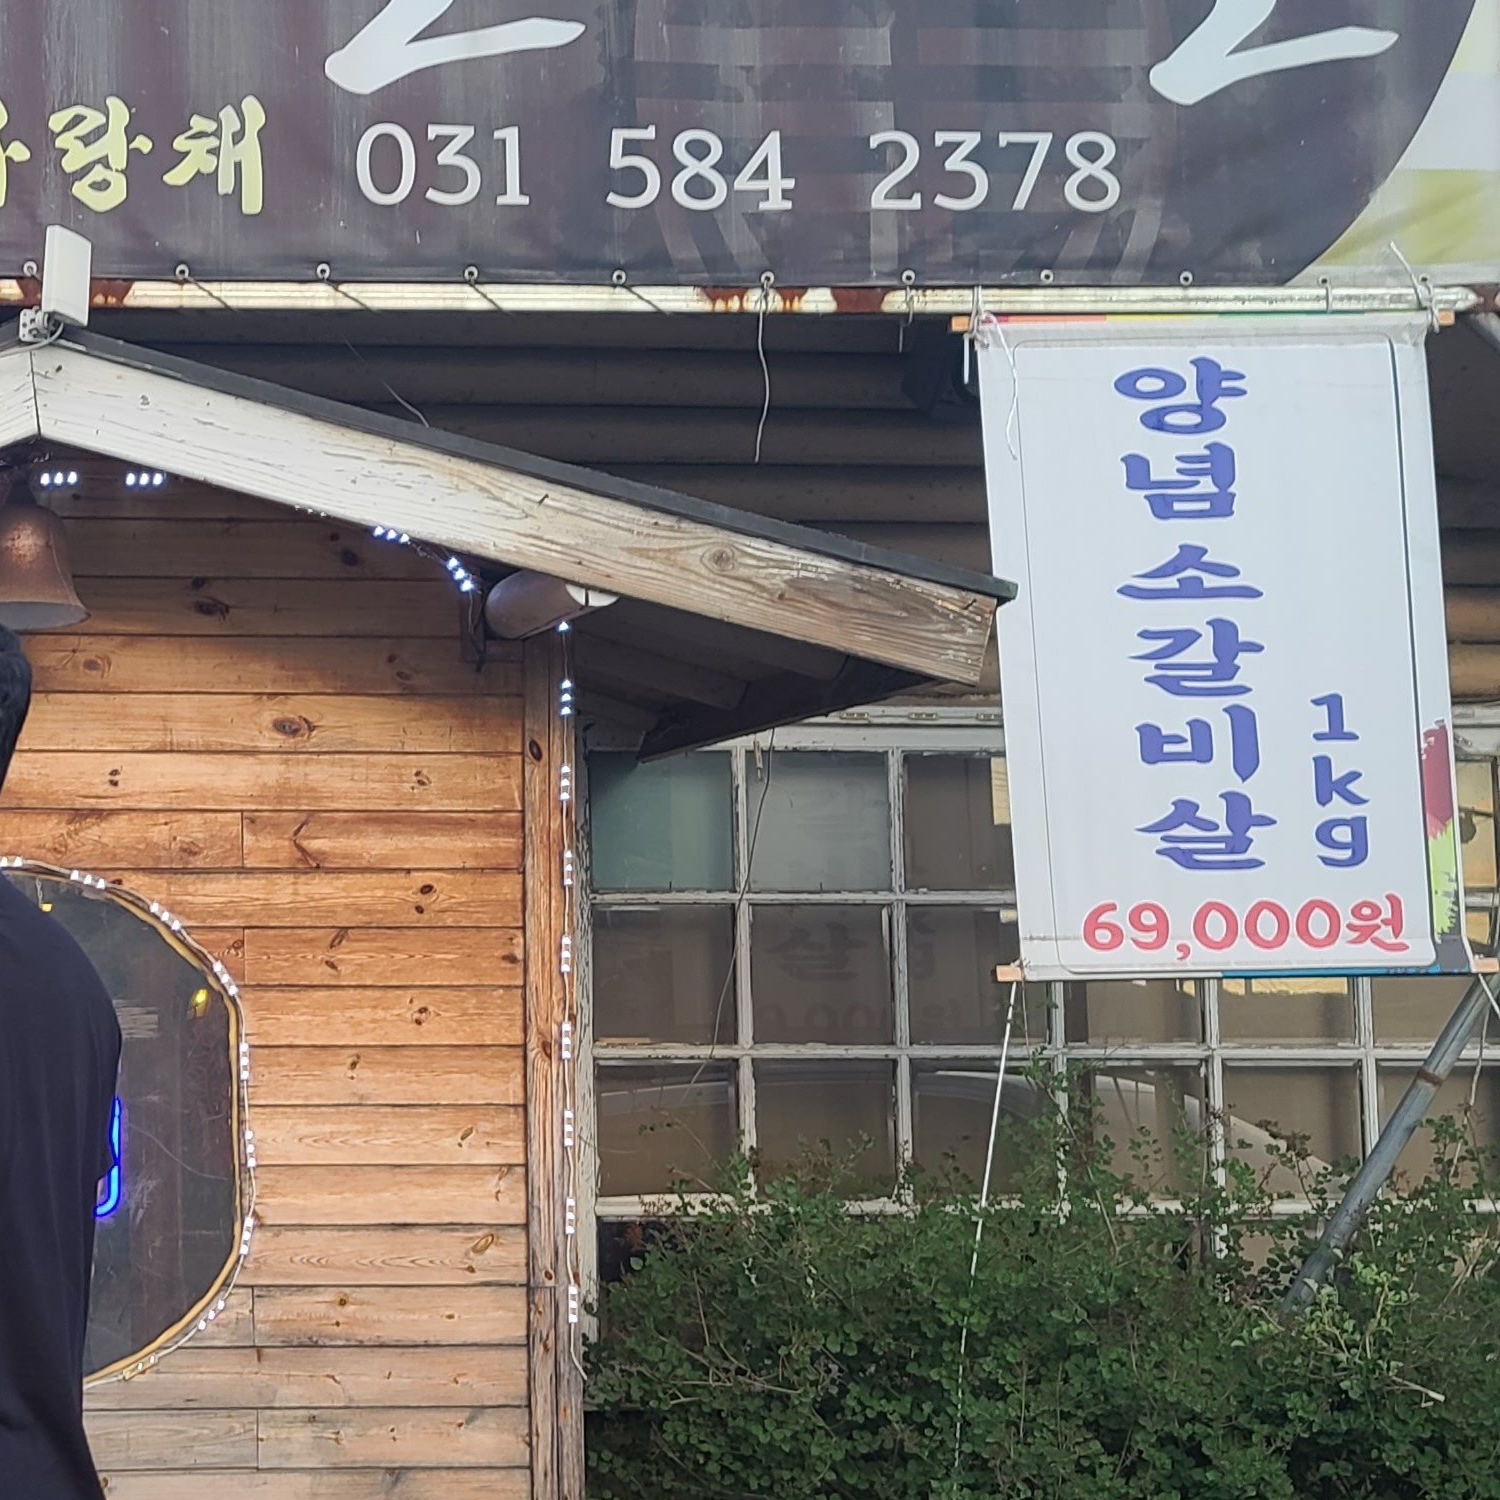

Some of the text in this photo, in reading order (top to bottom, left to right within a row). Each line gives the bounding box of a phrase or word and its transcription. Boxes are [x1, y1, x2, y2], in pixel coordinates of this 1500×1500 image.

[356, 121, 1122, 213] 031 584 2378
[1082, 892, 1410, 961] 69,000원
